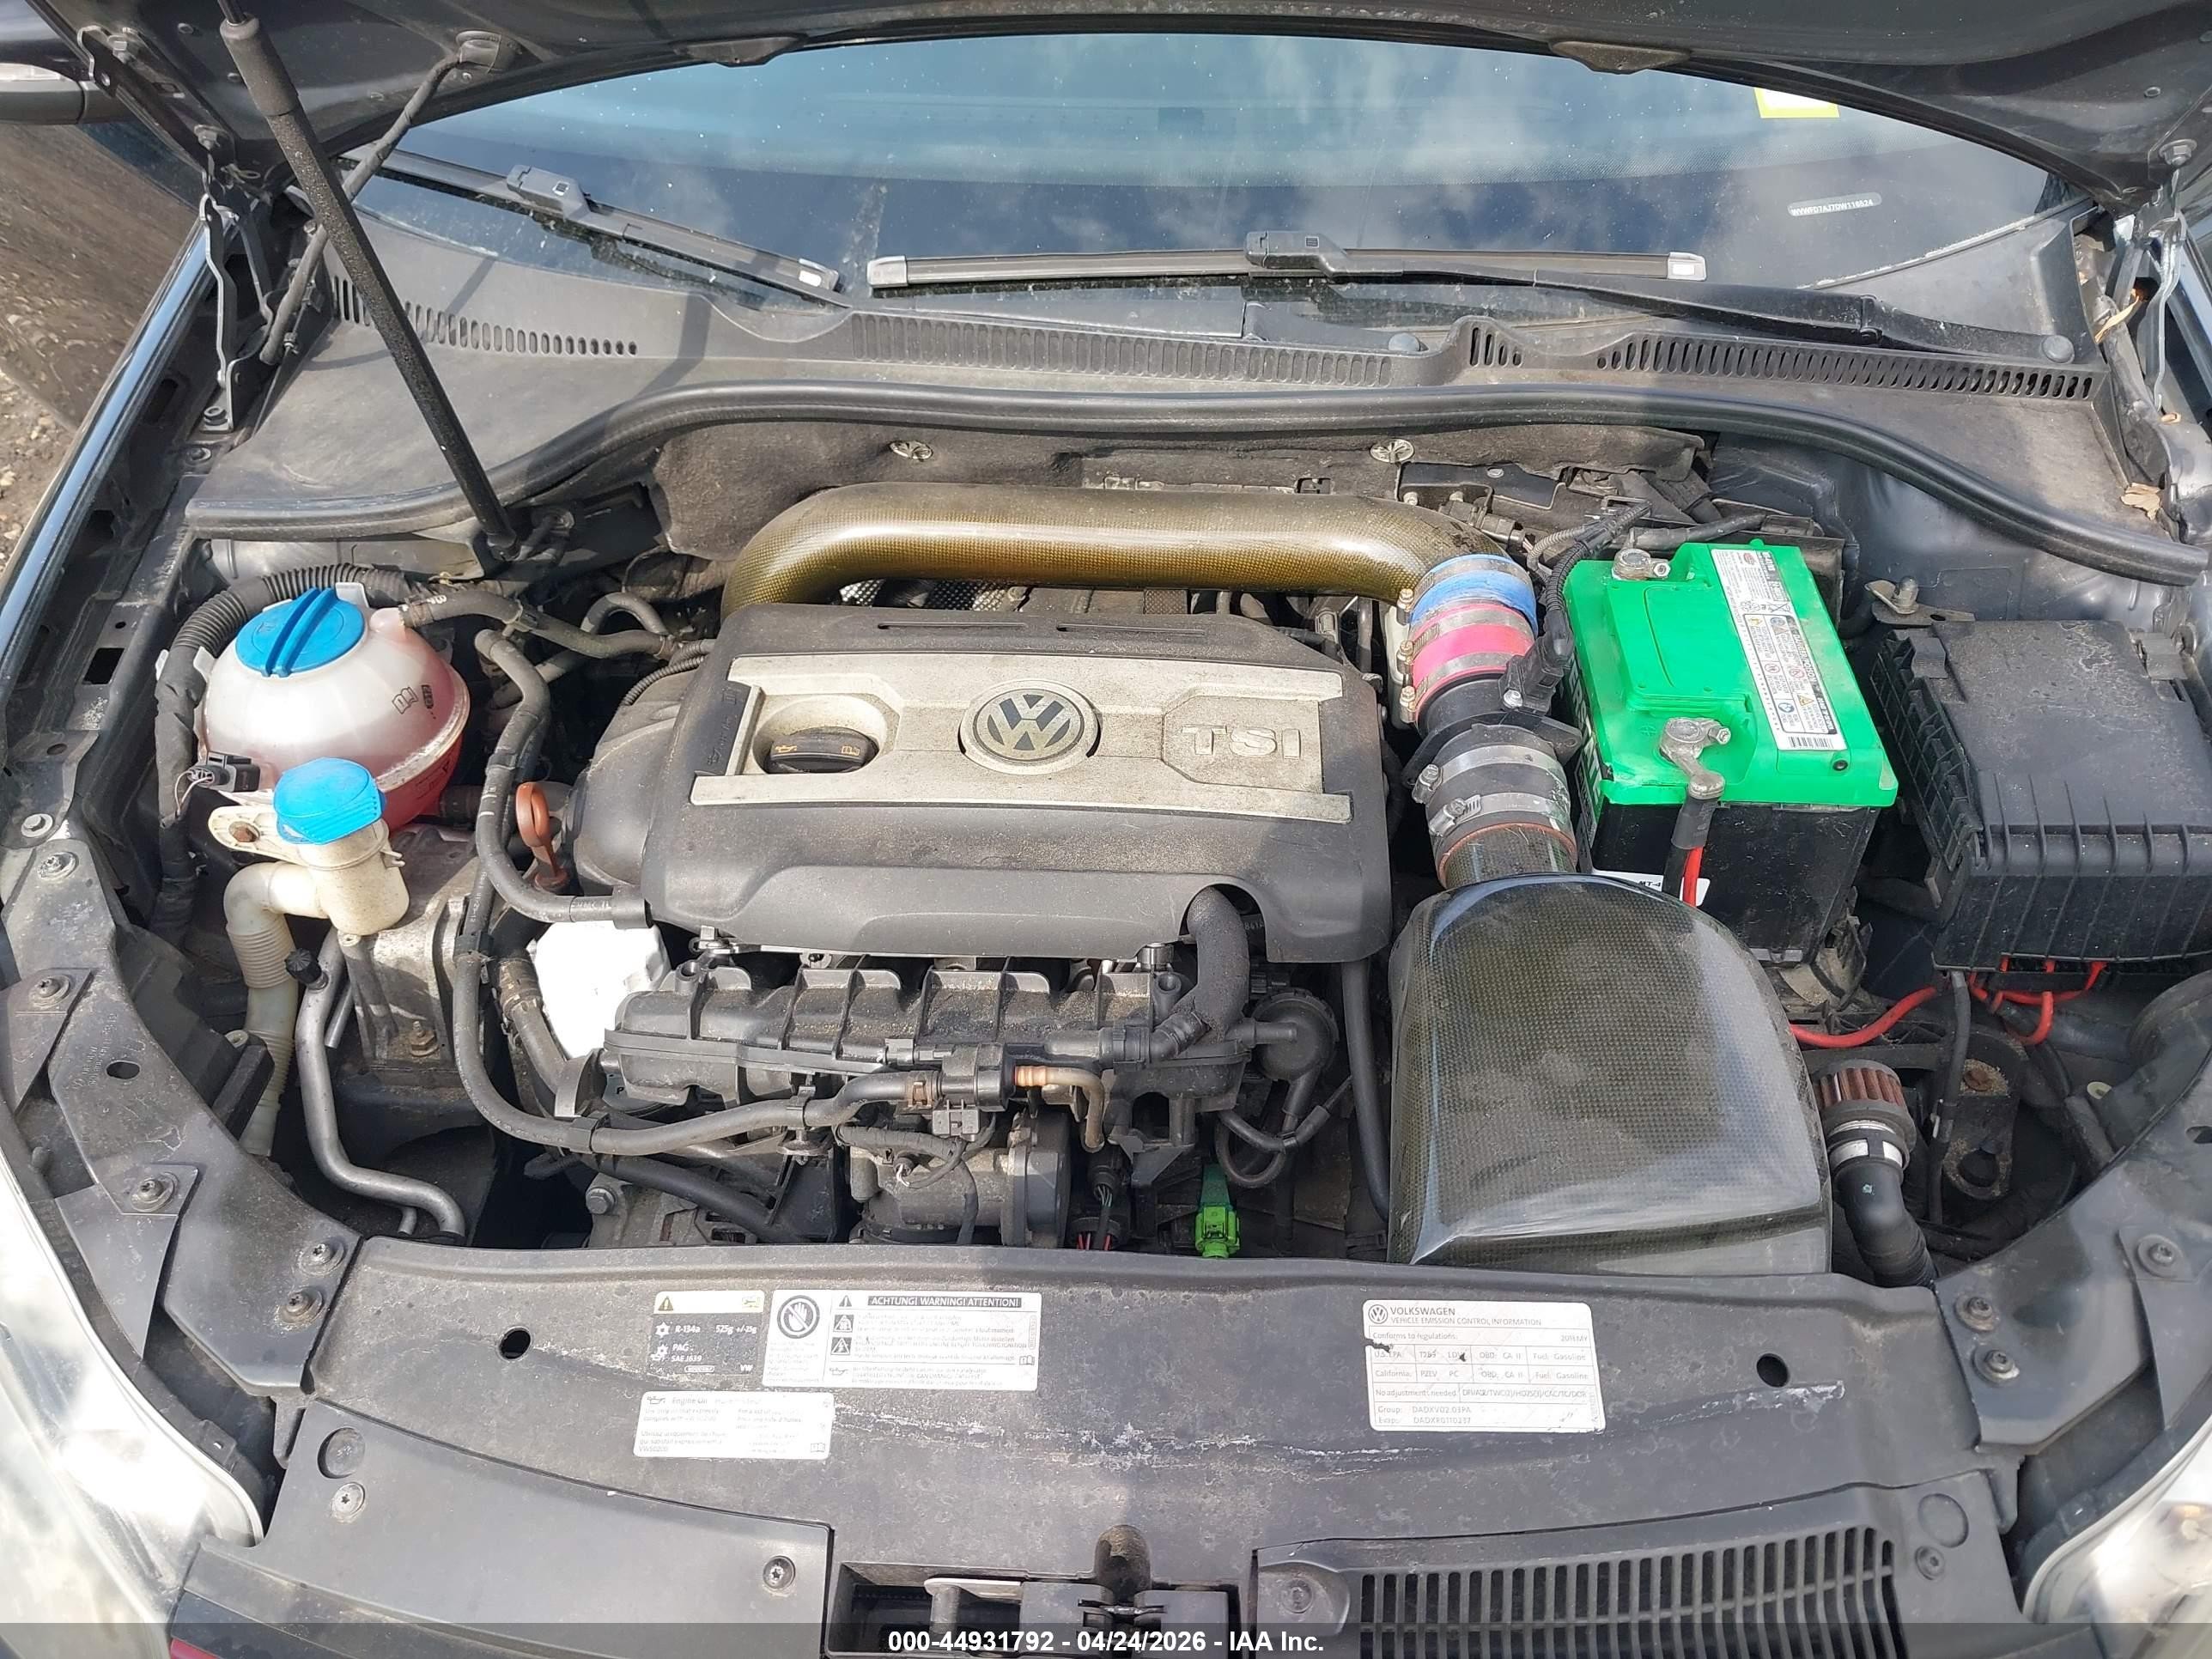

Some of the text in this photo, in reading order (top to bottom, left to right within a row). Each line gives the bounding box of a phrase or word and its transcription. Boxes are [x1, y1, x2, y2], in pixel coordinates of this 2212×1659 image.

[1181, 724, 1301, 759] TSI
[871, 1297, 1019, 1307] ACHTUNG! WARNING! ATTENTION!
[1390, 1306, 1455, 1316] VOLKSWAGEN
[1457, 1317, 1490, 1326] CONTROL
[1373, 1332, 1405, 1340] Conforms
